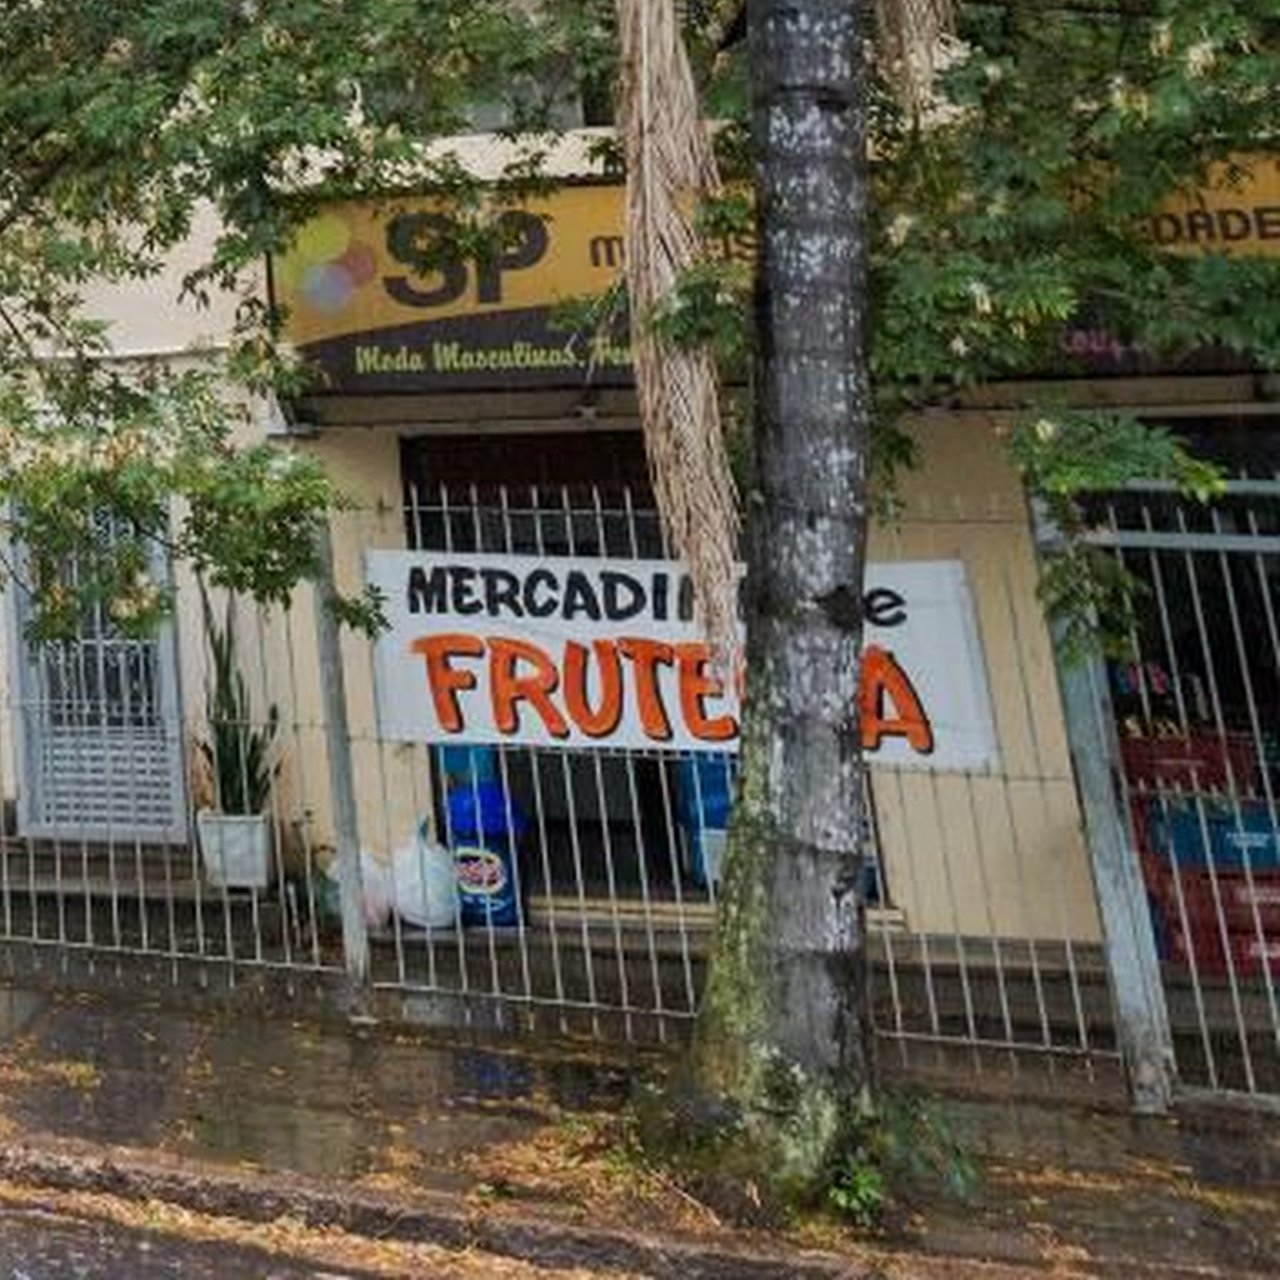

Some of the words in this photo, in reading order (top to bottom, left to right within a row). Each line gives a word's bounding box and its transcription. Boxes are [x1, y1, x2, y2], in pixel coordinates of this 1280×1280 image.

[383, 209, 550, 308] SP
[355, 344, 425, 374] Moda
[407, 565, 696, 622] MERCADI
[862, 587, 908, 627] e
[409, 631, 934, 755] FRUTEA
